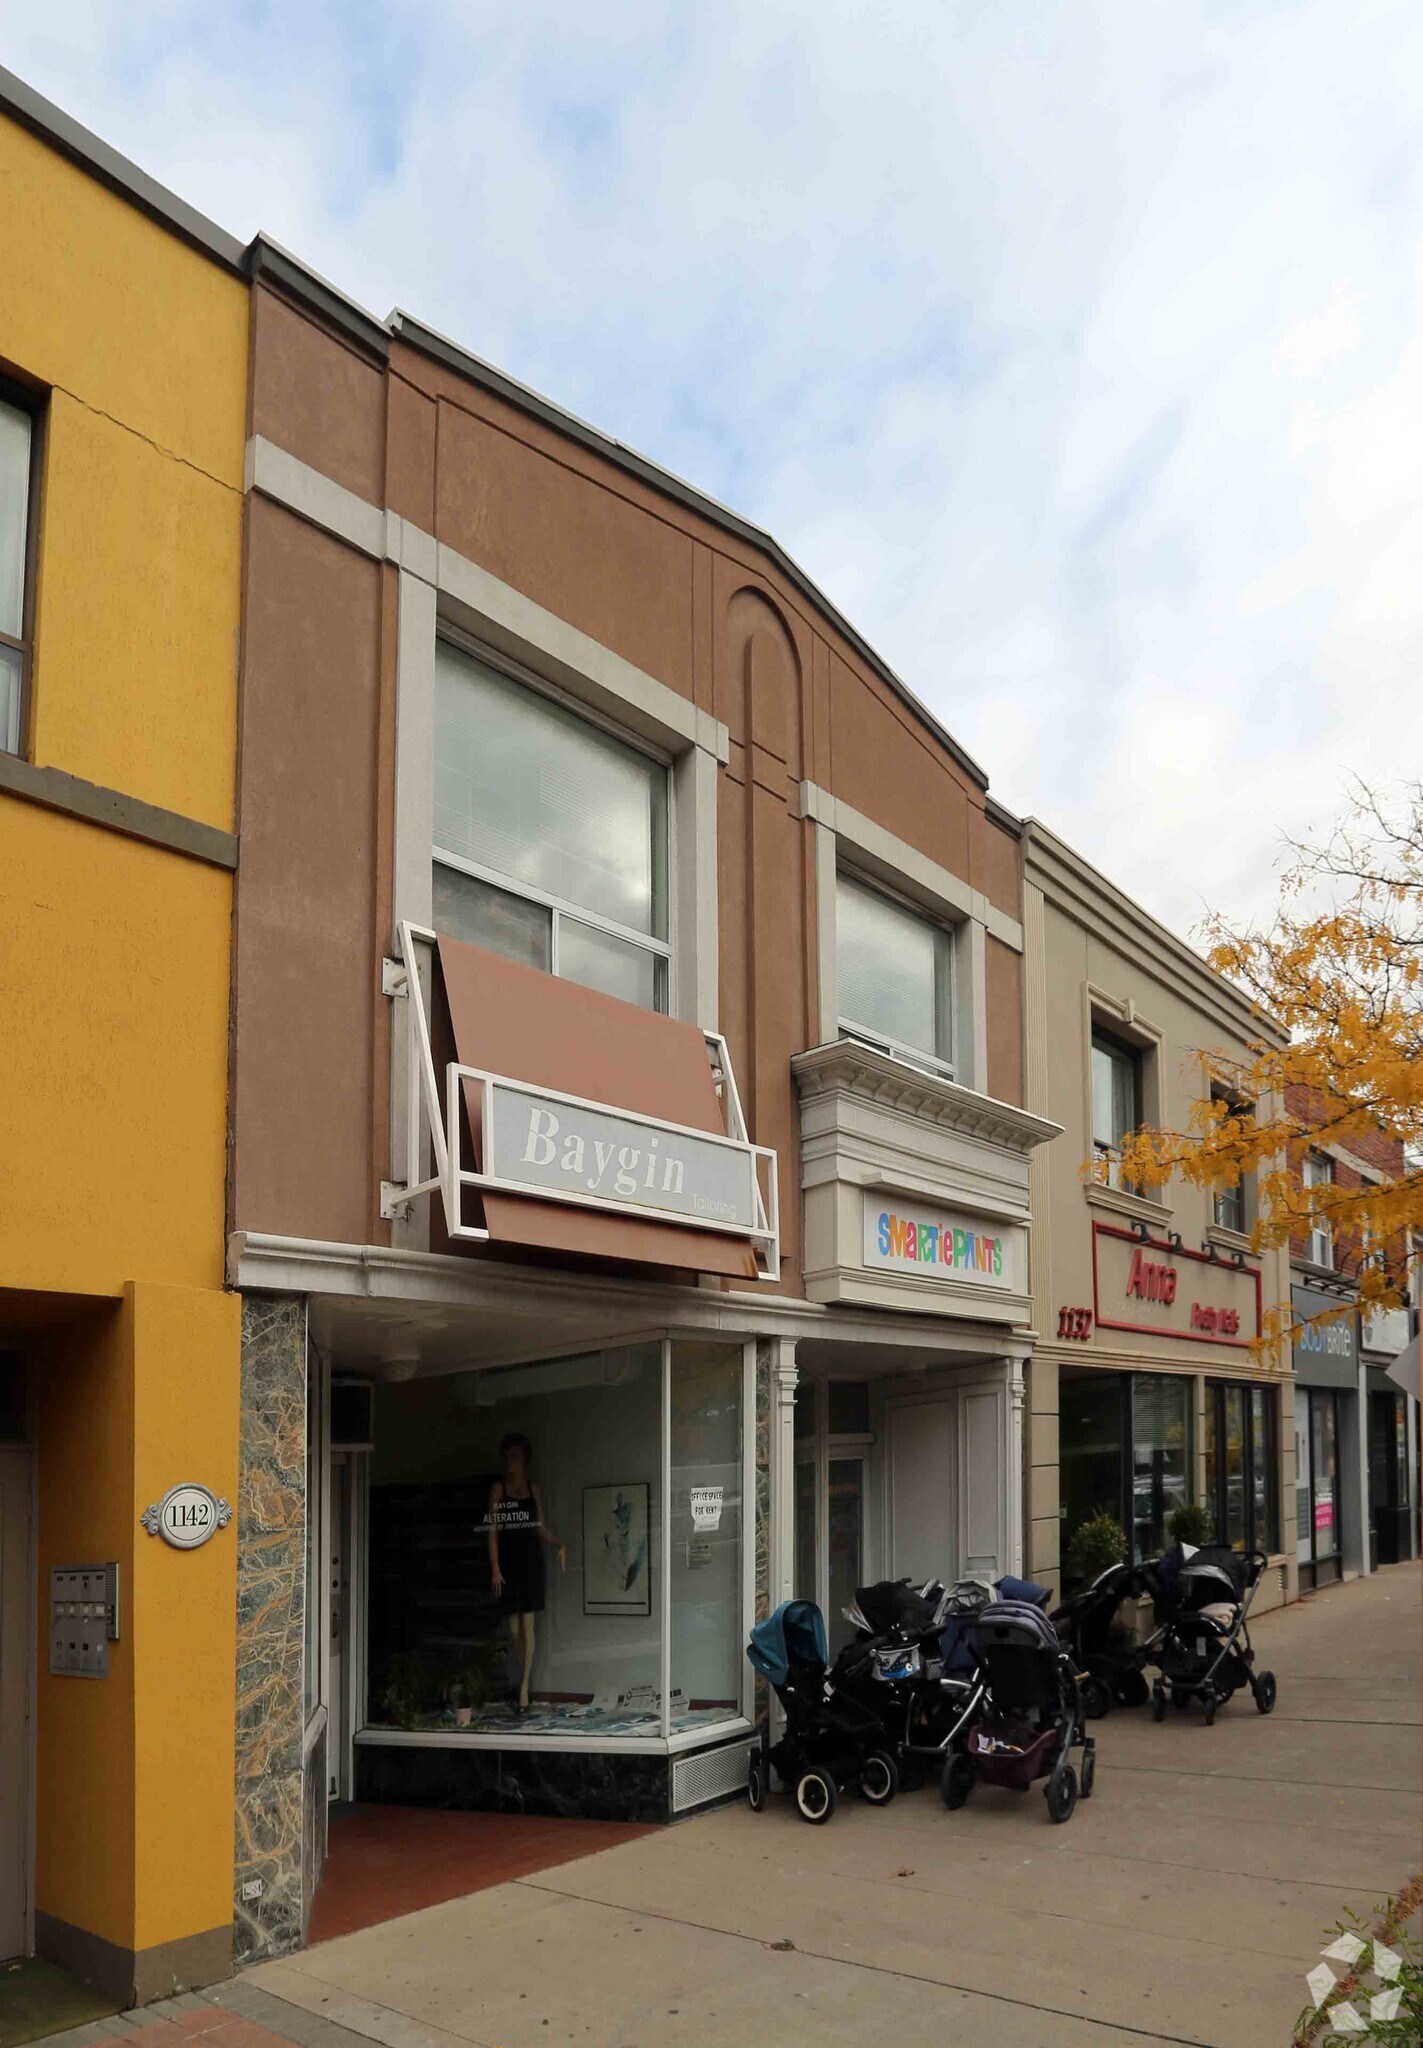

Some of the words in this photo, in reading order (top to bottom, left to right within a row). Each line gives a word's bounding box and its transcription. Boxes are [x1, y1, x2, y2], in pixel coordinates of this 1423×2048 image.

[519, 1105, 685, 1195] Baygin
[1126, 1248, 1178, 1305] Anna
[169, 1503, 209, 1527] 1142
